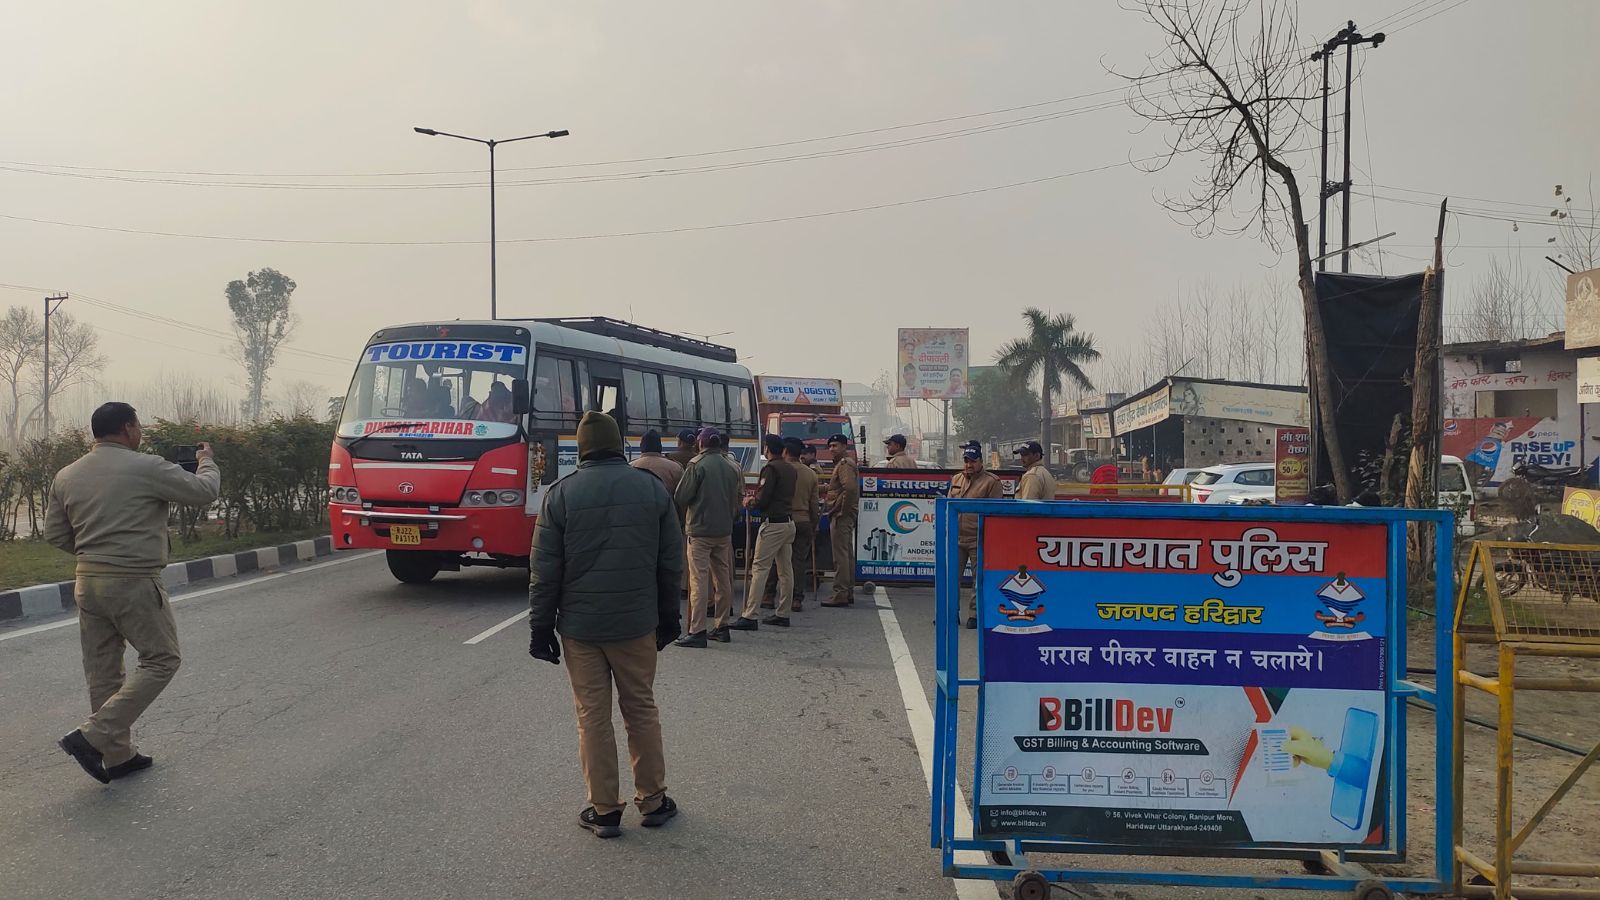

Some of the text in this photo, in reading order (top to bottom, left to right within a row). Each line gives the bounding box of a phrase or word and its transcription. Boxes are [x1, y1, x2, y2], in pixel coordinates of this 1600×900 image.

[368, 343, 523, 362] TOURIST
[767, 386, 794, 394] SPEED
[415, 422, 474, 435] PARIHAR
[881, 479, 948, 490] उत्तराखण्ड
[1036, 527, 1329, 588] यातायात पुलिस
[1097, 598, 1264, 625] जनपद हरिद्वार
[1038, 646, 1092, 667] शराब
[1100, 639, 1156, 668] पीकर
[1163, 648, 1217, 671] वाहन
[1225, 650, 1243, 669] न
[1022, 738, 1200, 752] GST Billing & Accounting Software
[1000, 809, 1046, 817] info@billdev.in
[1144, 812, 1161, 820] Vihar
[1189, 813, 1215, 822] Ranipur
[1126, 822, 1155, 830] Haridwar
